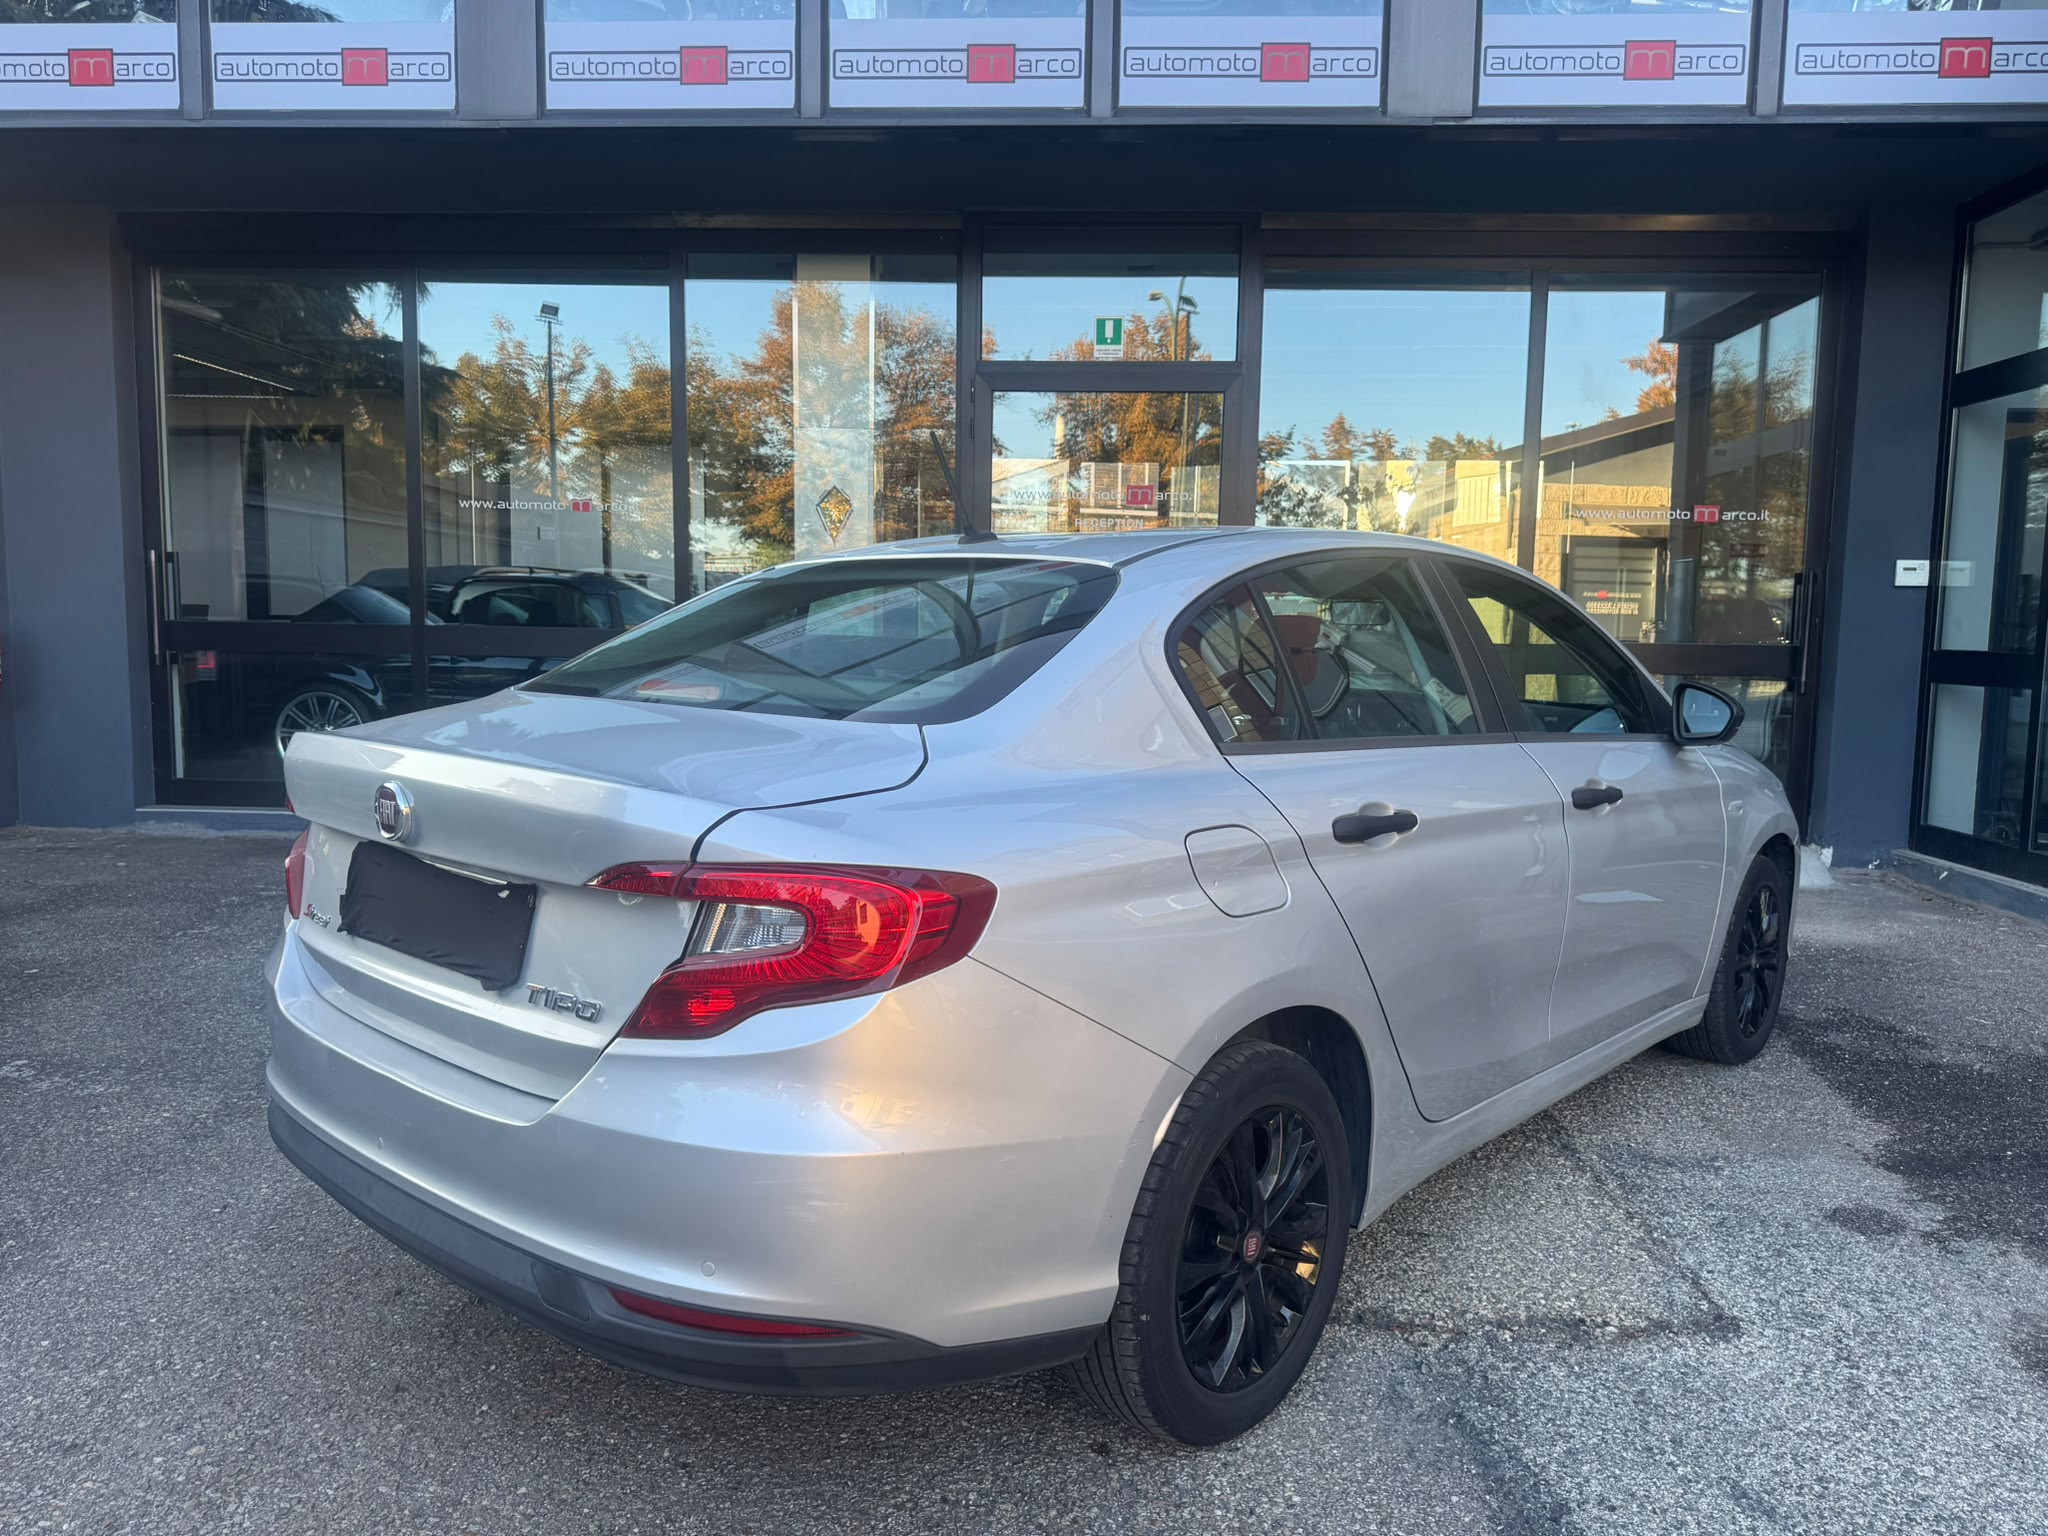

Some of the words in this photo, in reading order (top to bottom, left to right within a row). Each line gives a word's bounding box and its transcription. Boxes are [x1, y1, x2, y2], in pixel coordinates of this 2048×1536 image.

[1074, 518, 1144, 529] RECEPTION
[379, 798, 396, 826] FIAT
[525, 982, 603, 1024] TIPO
